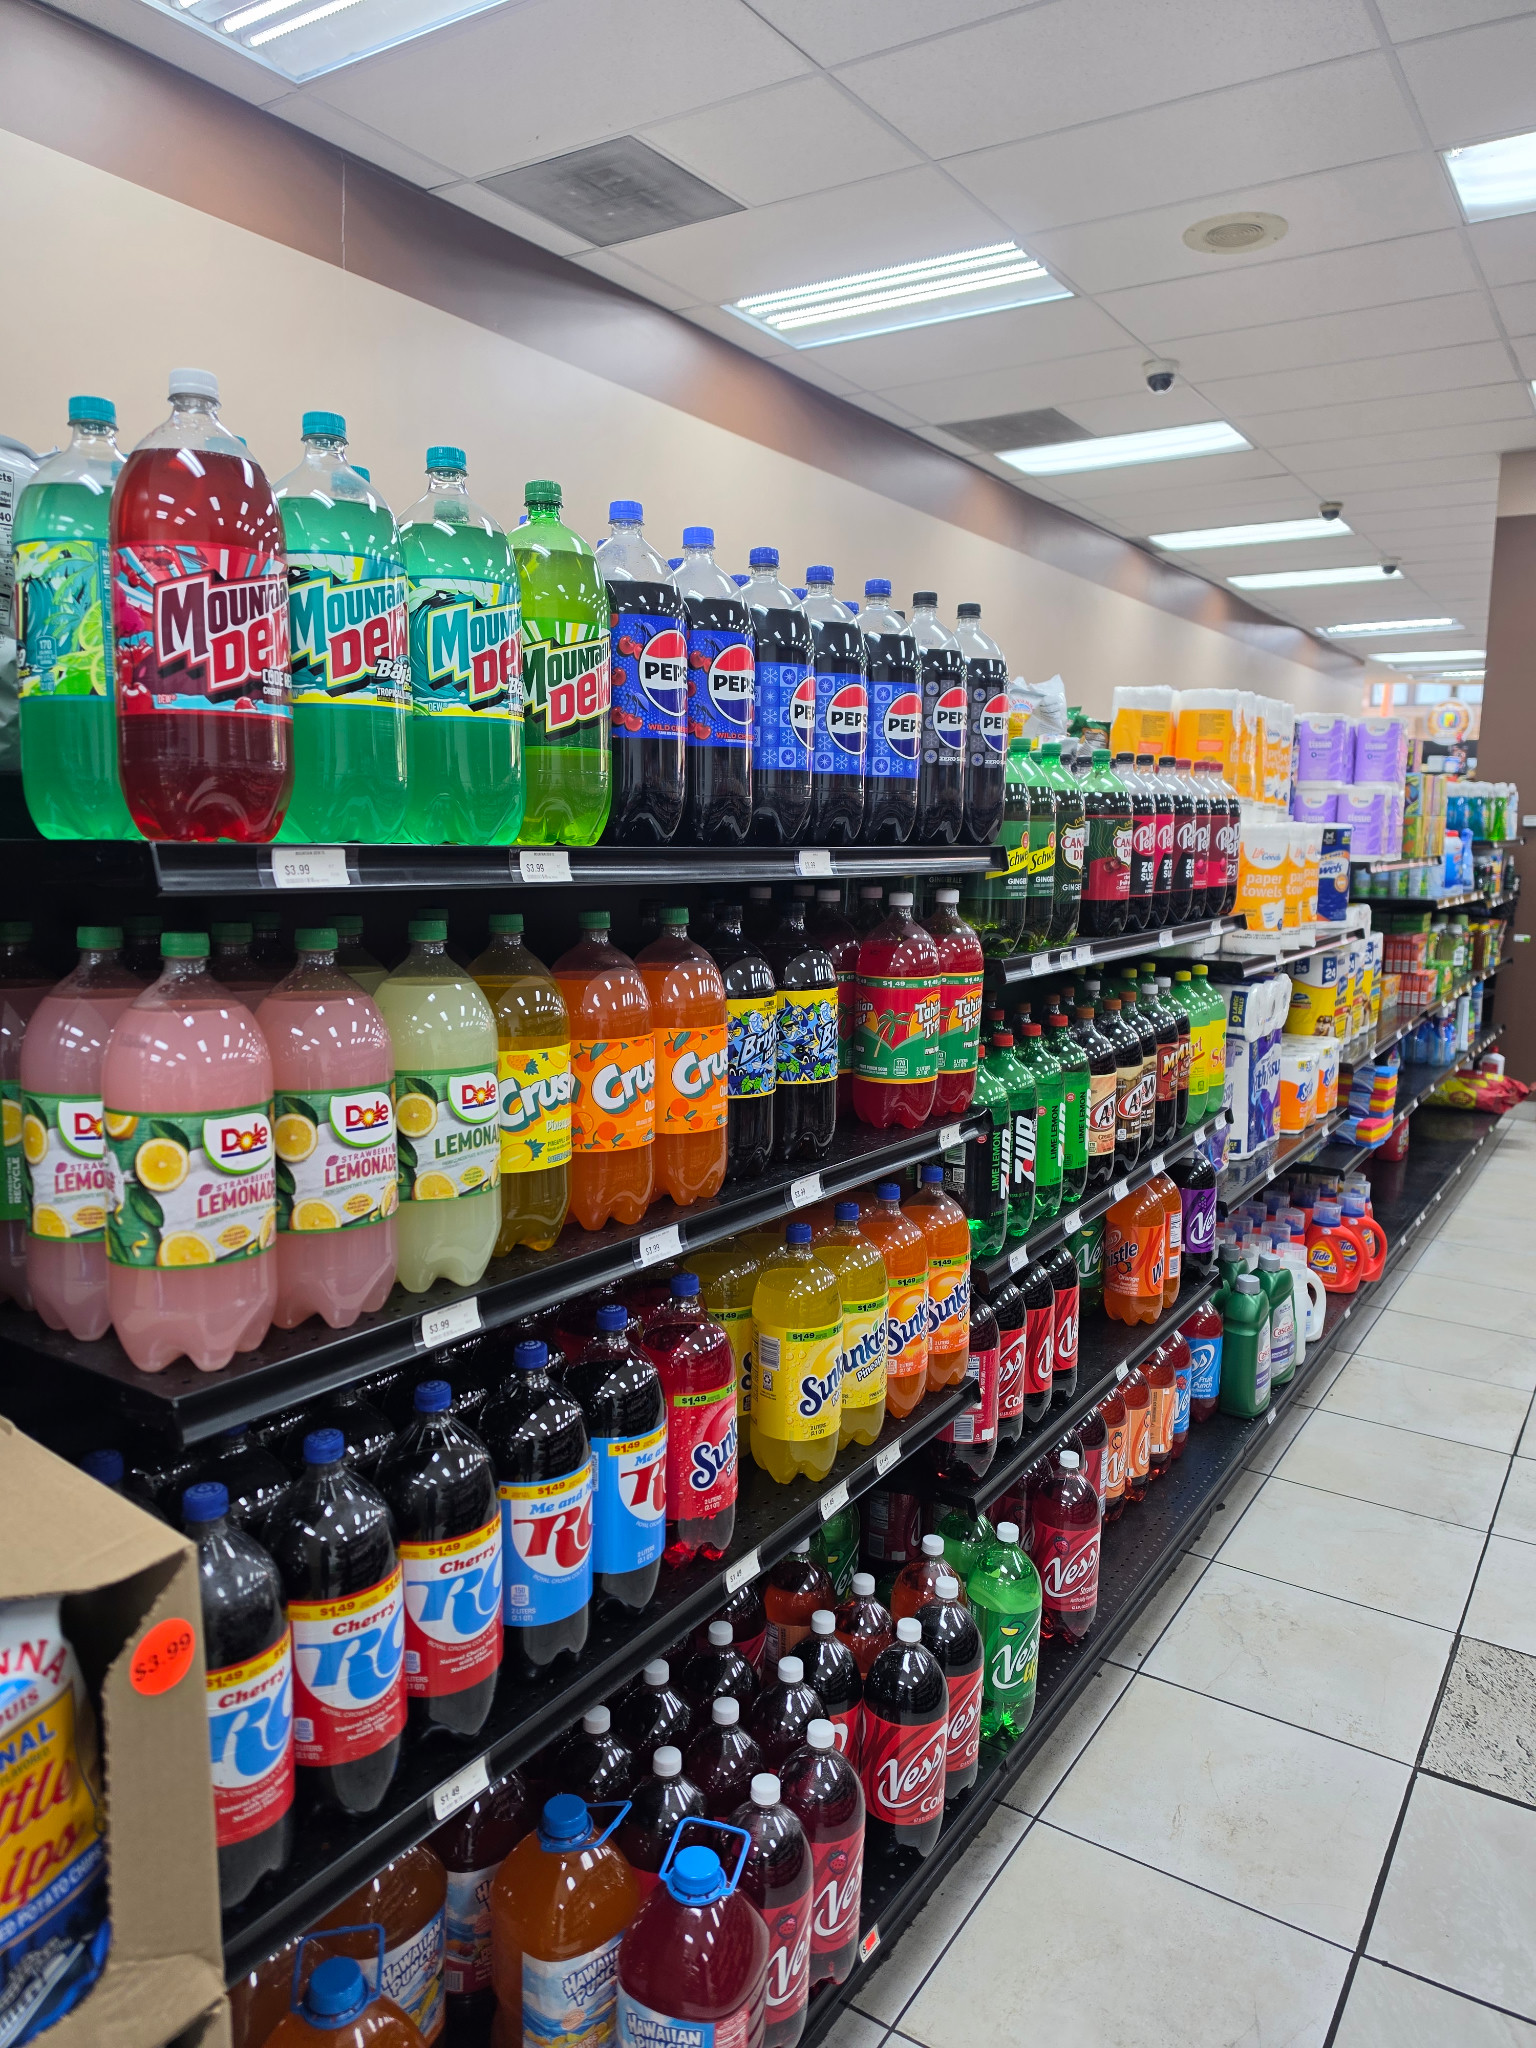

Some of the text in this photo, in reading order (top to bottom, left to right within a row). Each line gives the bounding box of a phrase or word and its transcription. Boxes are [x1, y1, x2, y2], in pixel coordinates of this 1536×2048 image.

[428, 702, 443, 712] DEW
[648, 723, 670, 732] WILD
[284, 864, 310, 876] $3.99
[526, 863, 545, 873] $3.99
[1227, 864, 1236, 877] 23
[1246, 873, 1283, 886] paper
[1241, 884, 1283, 898] towels
[1325, 968, 1336, 979] 24
[883, 980, 906, 988] $1.49
[1232, 1015, 1242, 1024] 9
[461, 1080, 496, 1105] Dole
[345, 1101, 389, 1126] Dole
[220, 1122, 268, 1152] Dole
[1050, 1105, 1059, 1160] LIME LEMON
[1015, 1115, 1036, 1184] 7UP
[991, 1131, 1000, 1192] LIME LEMON
[12, 1157, 21, 1204] RECYCLE
[645, 1243, 660, 1255] $3.99
[1312, 1250, 1331, 1261] Tide
[932, 1259, 952, 1268] $1.49
[897, 1277, 916, 1286] $1.49
[1118, 1273, 1139, 1282] Orange
[857, 1302, 877, 1312] $1.49
[714, 1312, 737, 1321] $1.49
[429, 1319, 450, 1335] $3.99
[792, 1332, 815, 1342] $1.49
[682, 1395, 707, 1406] $1.49
[614, 1440, 640, 1453] $1.49
[634, 1452, 653, 1467] Me
[537, 1481, 565, 1496] $1.49
[620, 1453, 666, 1512] R
[529, 1489, 583, 1516] Me and
[513, 1491, 593, 1569] RC
[427, 1543, 461, 1557] $1.49
[439, 1542, 496, 1575] Cherry
[1044, 1546, 1098, 1593] Vess
[532, 1573, 551, 1584] ROYAL
[551, 1574, 572, 1585] CROWN
[406, 1546, 502, 1636] RC
[514, 1586, 526, 1594] 150
[320, 1601, 356, 1617] $1.49
[332, 1600, 396, 1637] Cherry
[296, 1603, 404, 1701] RC
[426, 1639, 447, 1652] ROYAL
[447, 1640, 472, 1652] CROWN
[133, 1632, 192, 1682] $3.99
[439, 1653, 465, 1666] Natural
[450, 1660, 475, 1674] Natural
[207, 1669, 243, 1689] $1.49
[218, 1665, 285, 1709] Cherry
[877, 1740, 945, 1802] Vess
[626, 2012, 703, 2047] HAWAIIAN
